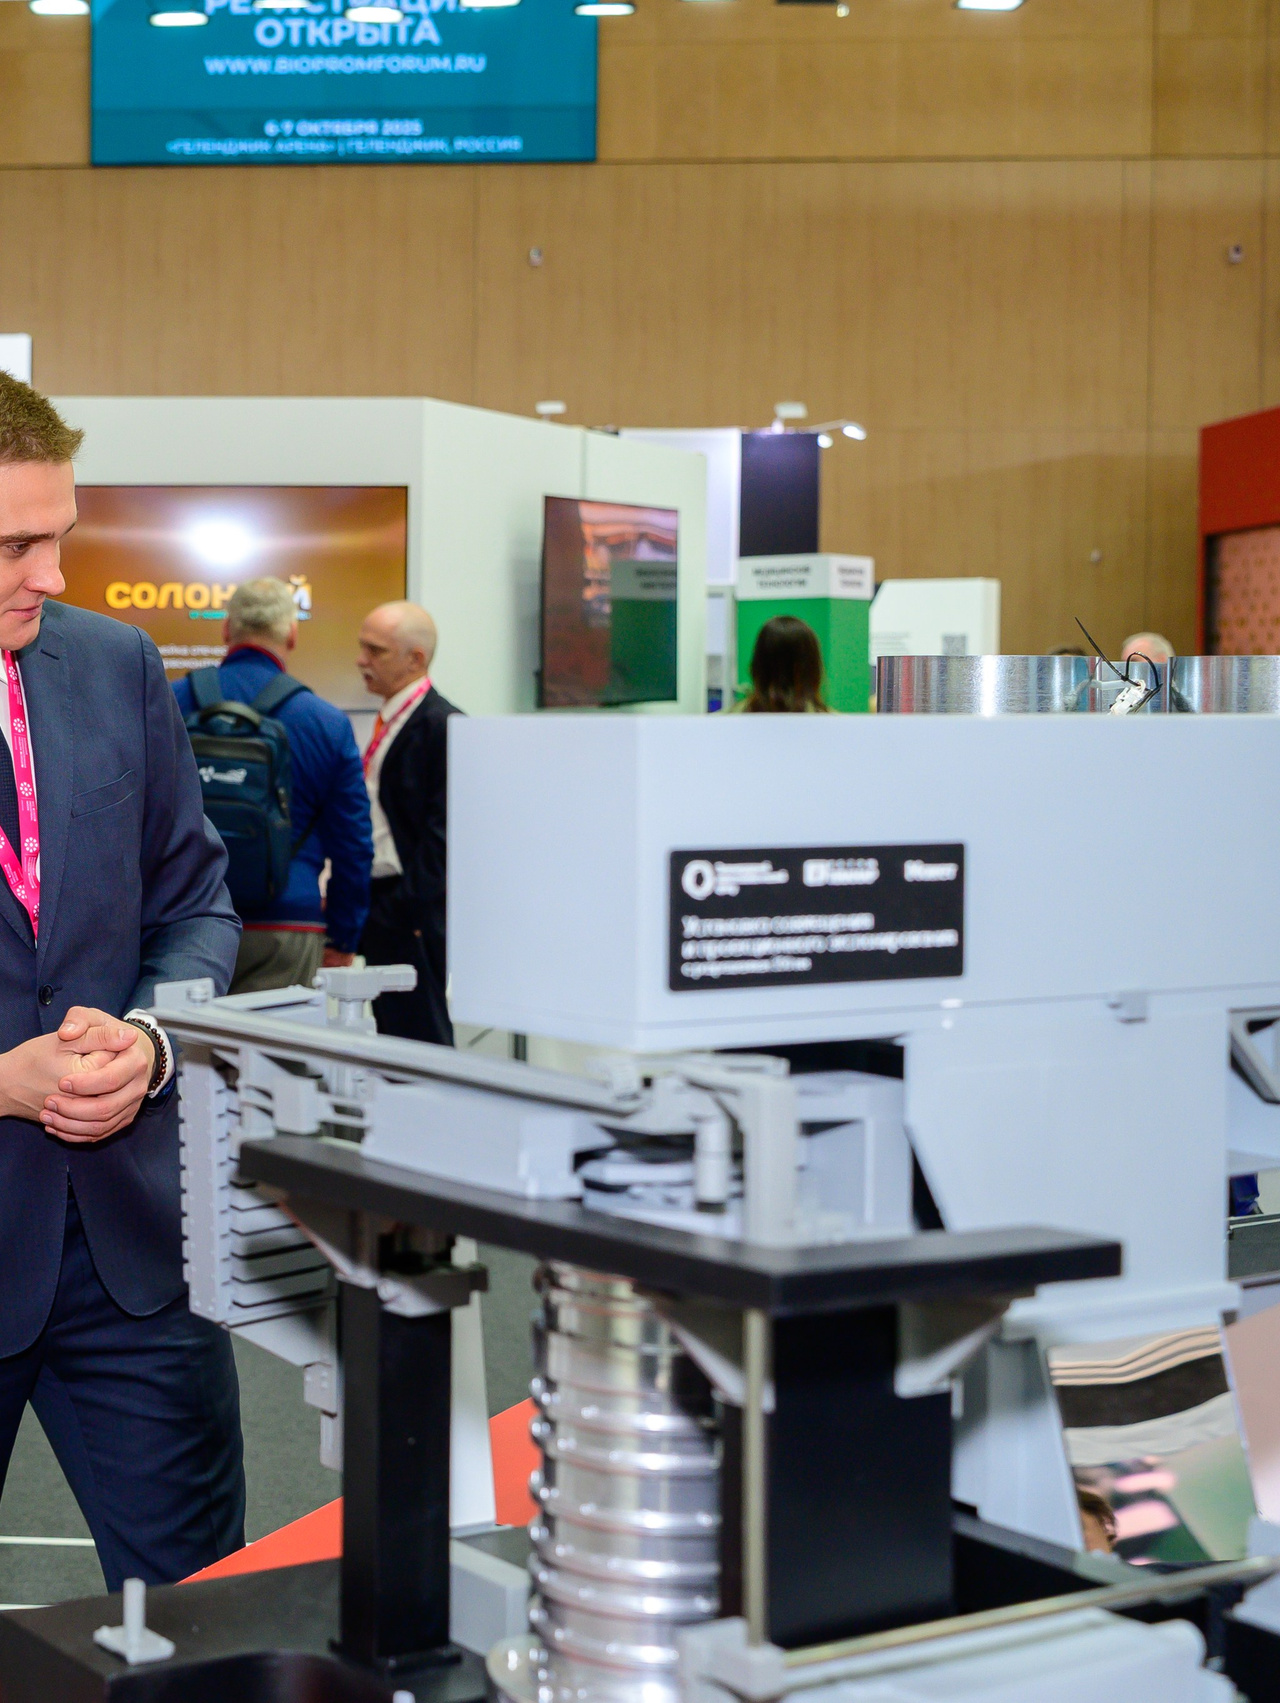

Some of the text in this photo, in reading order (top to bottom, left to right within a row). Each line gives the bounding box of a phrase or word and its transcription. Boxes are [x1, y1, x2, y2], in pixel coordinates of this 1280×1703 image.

[254, 17, 442, 48] ОТКРЫТА
[203, 53, 487, 75] WWW.BIOPROMFORUM.RU
[296, 119, 379, 137] ОКТЯБРЯ
[381, 119, 424, 136] 2025
[453, 135, 524, 154] РОССИЯ
